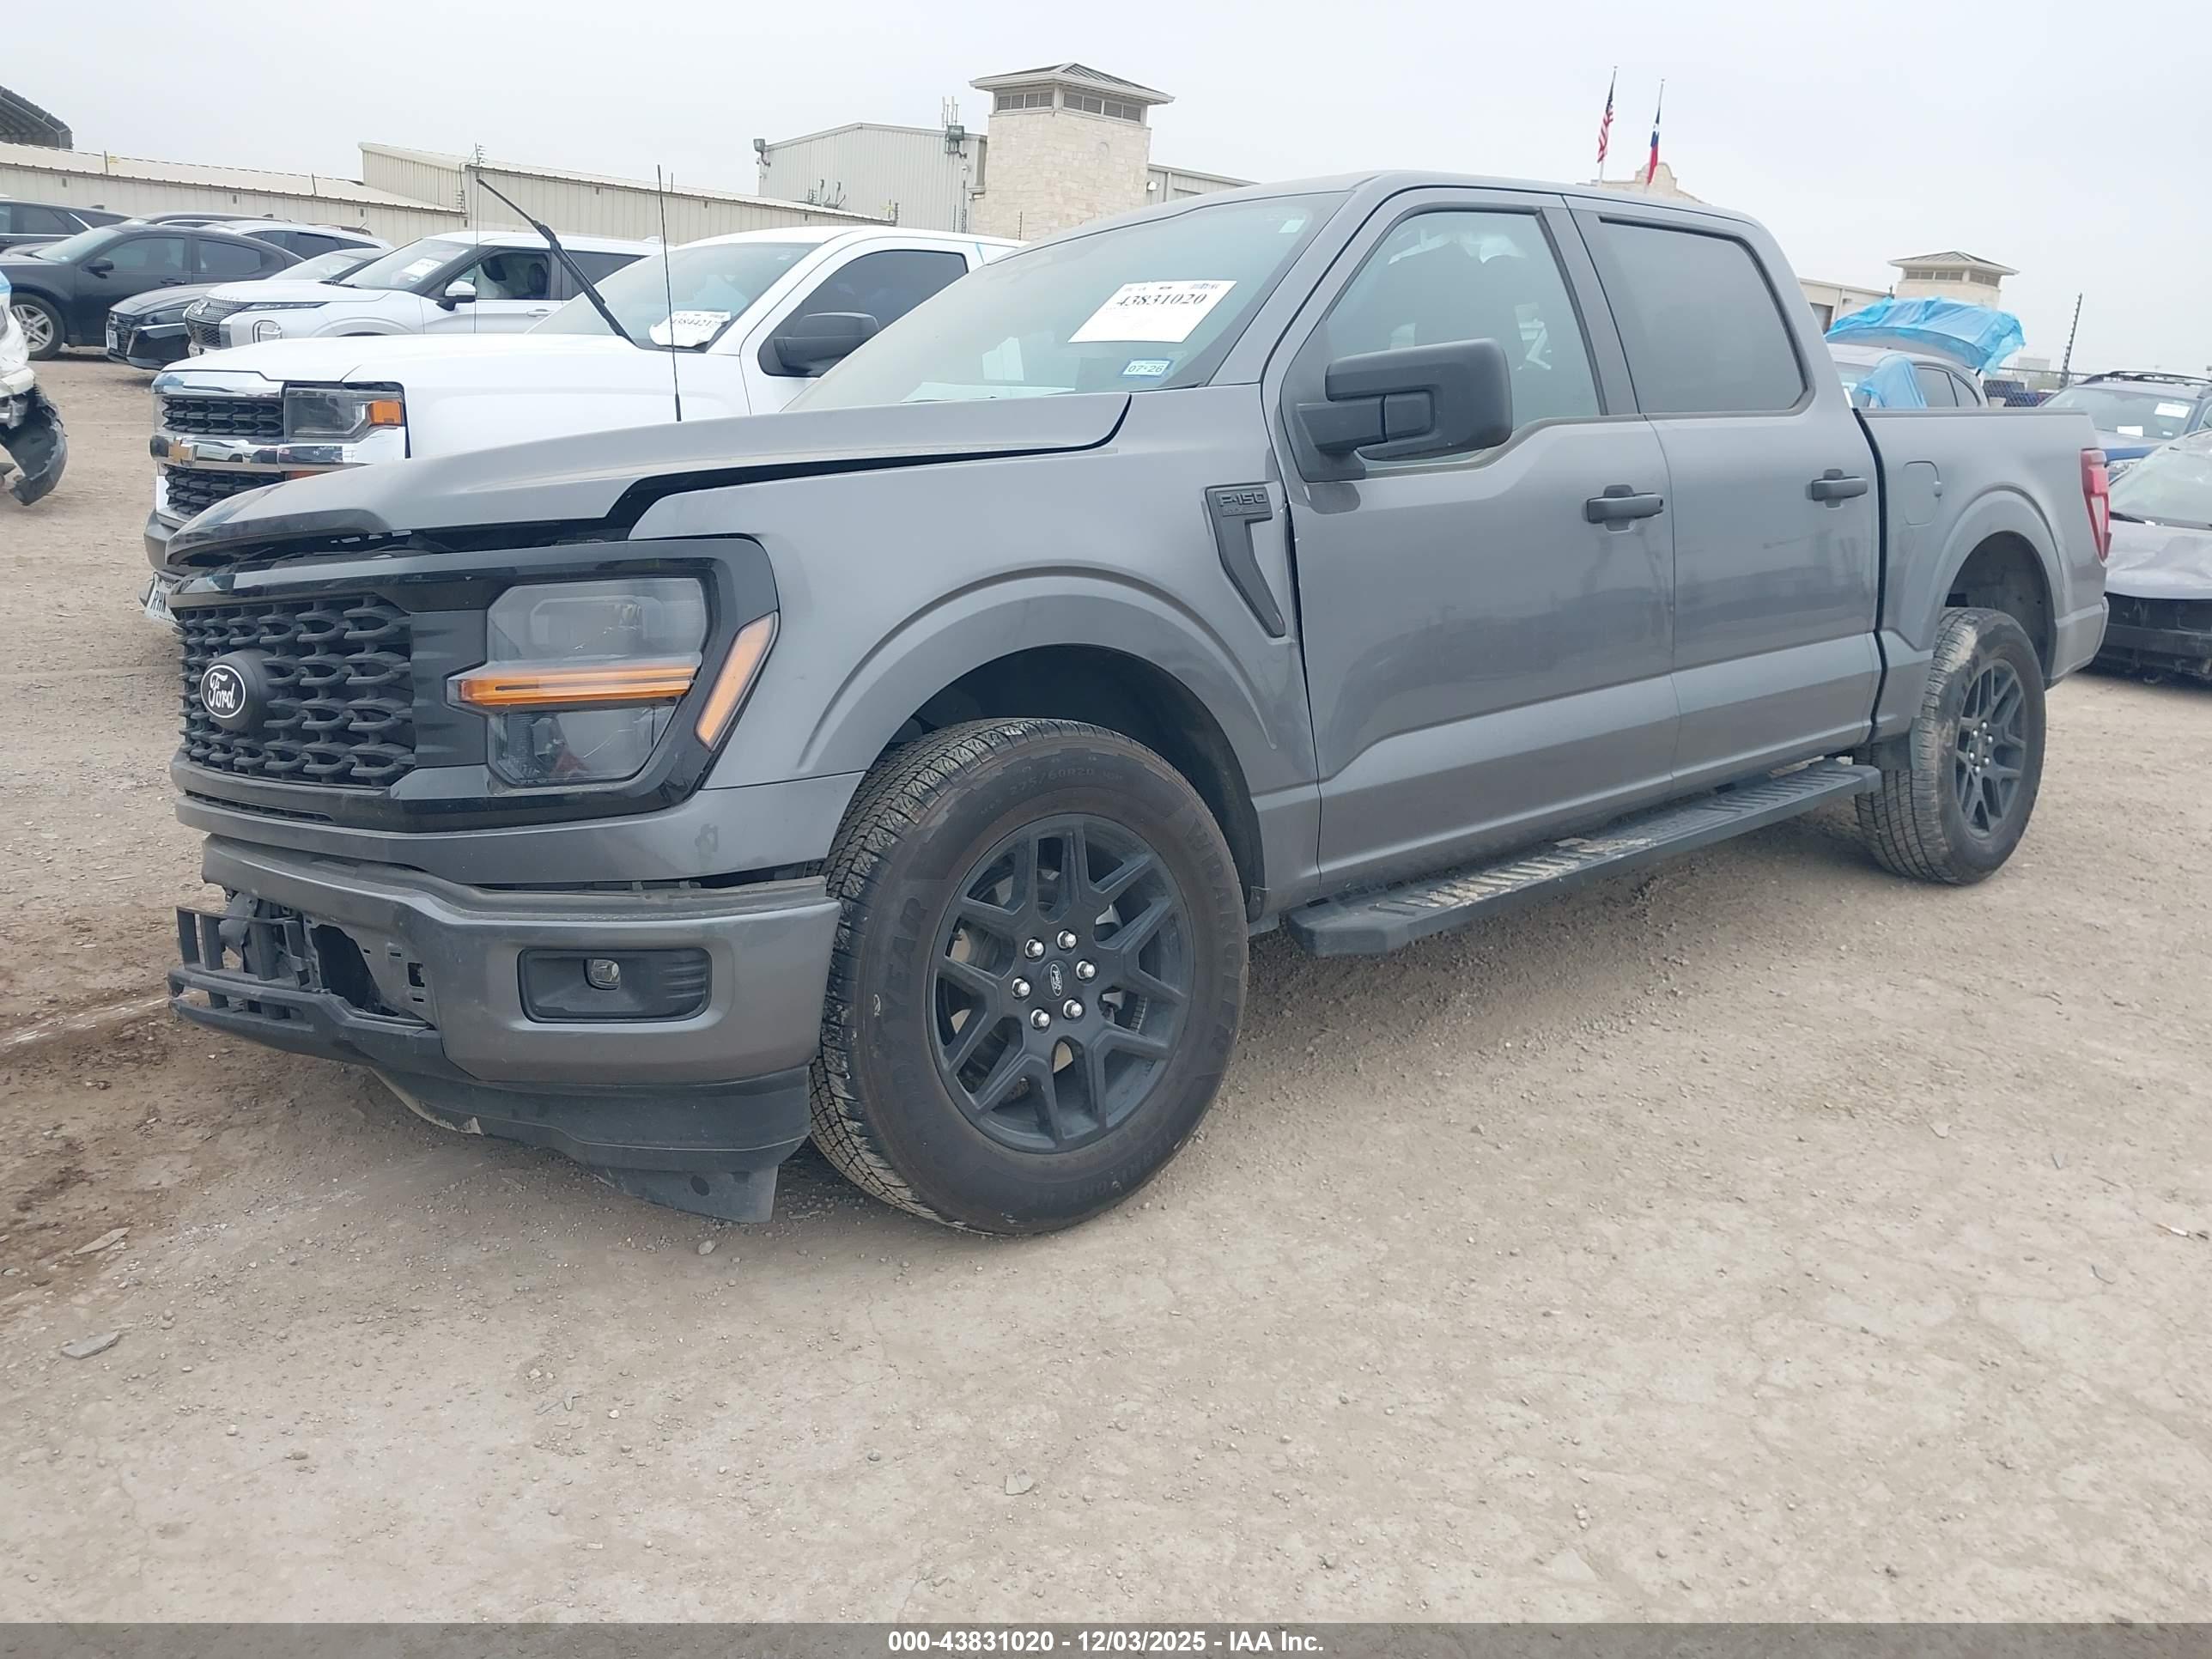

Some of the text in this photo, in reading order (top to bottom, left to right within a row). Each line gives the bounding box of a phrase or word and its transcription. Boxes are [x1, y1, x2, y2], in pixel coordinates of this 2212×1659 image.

[1116, 293, 1207, 307] 43831020
[1219, 491, 1267, 507] F-150
[208, 672, 236, 709] Ford
